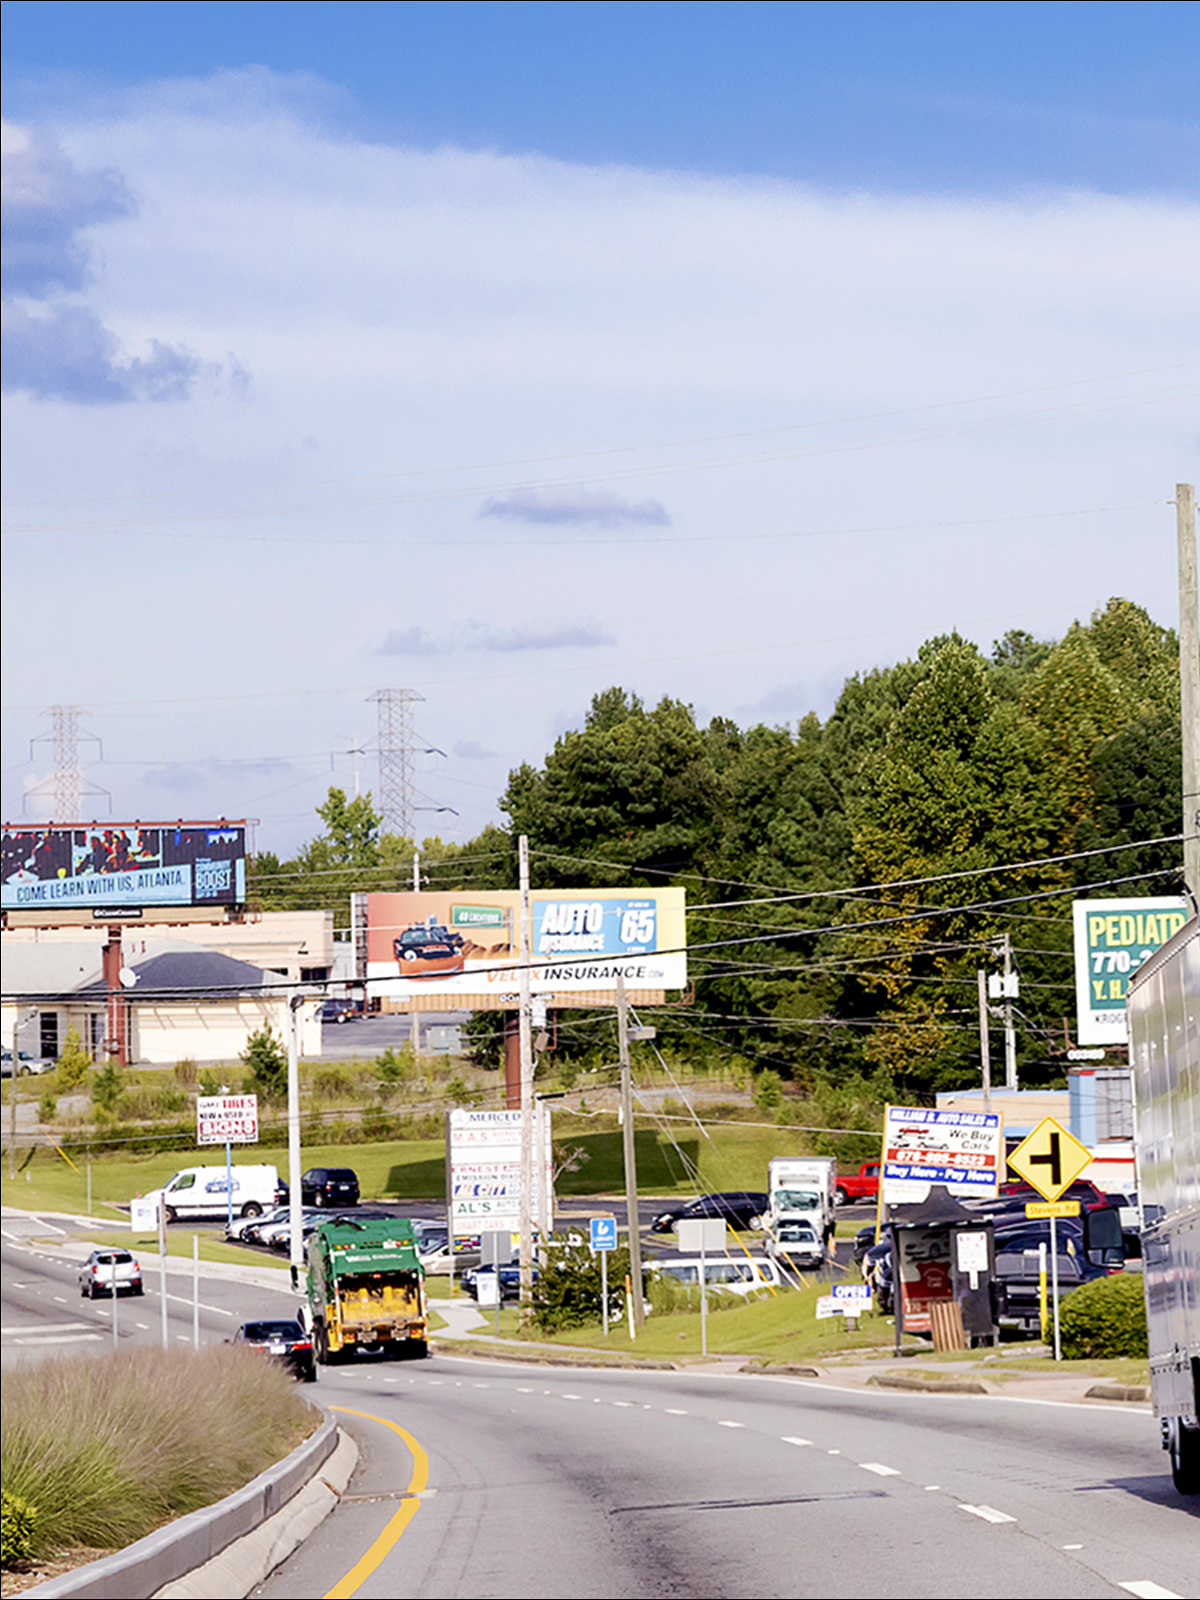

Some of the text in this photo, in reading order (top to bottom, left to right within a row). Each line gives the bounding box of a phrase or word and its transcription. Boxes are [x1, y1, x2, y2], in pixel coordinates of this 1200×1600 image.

[195, 869, 232, 890] BOOST
[16, 870, 185, 902] COME LEARN WITH US, ATLANTA.
[540, 902, 603, 934] AUTO
[487, 969, 541, 982] VELX
[222, 1098, 254, 1109] TIRES
[949, 1129, 995, 1142] We Buy
[961, 1140, 990, 1151] Cars
[452, 1165, 499, 1173] ERNEST
[886, 1165, 994, 1182] Buy Here Pay Here
[457, 1202, 491, 1213] AL'S
[1029, 1204, 1076, 1216] Stevens Rd
[835, 1286, 867, 1298] OPEN
